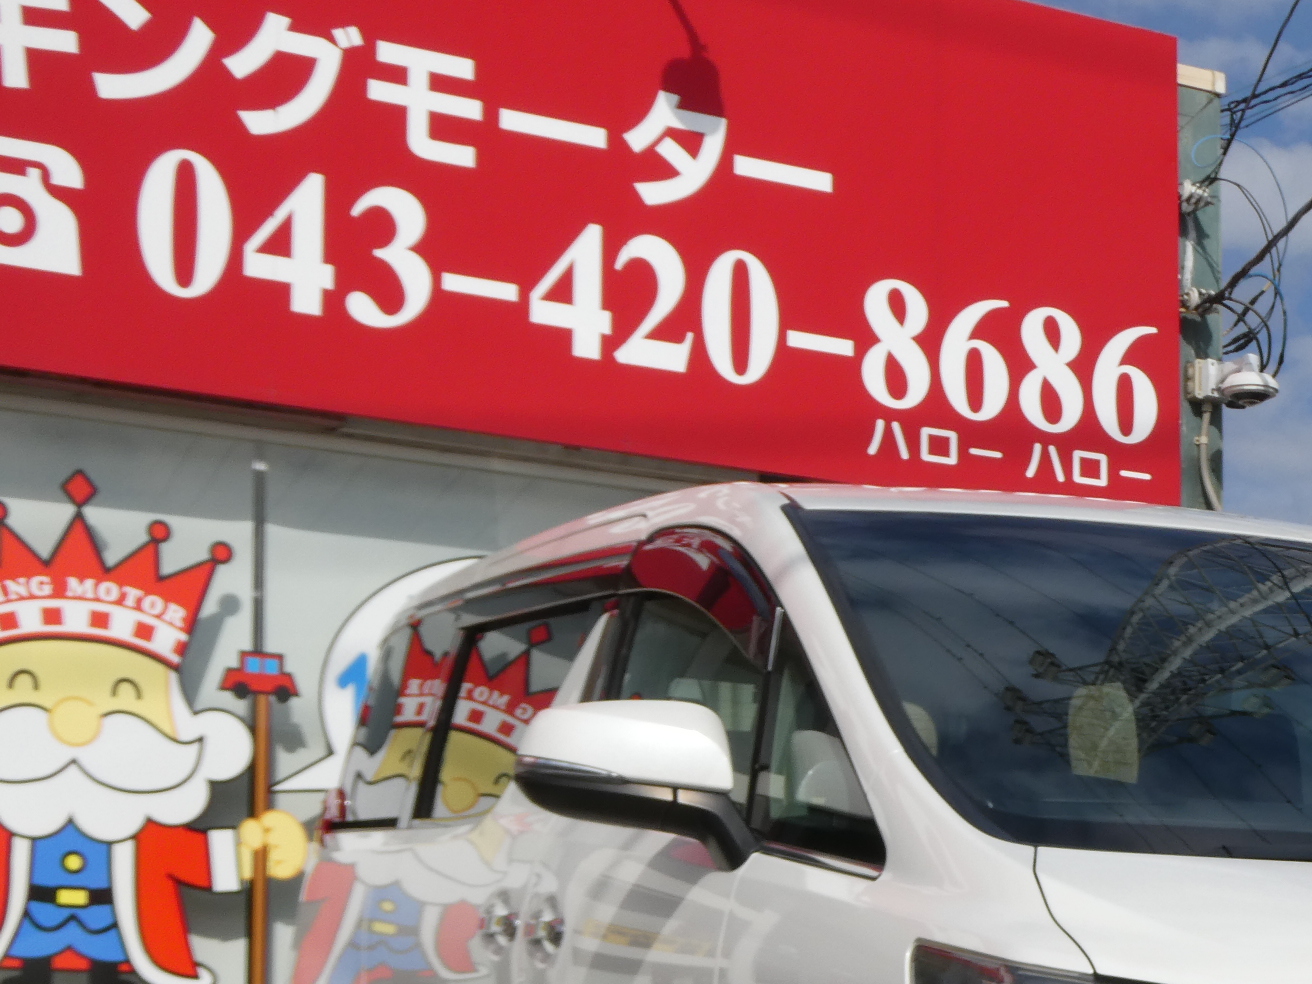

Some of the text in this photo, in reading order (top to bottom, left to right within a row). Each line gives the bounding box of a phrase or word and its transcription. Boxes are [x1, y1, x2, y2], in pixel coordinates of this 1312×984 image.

[866, 418, 1153, 487] ハロー ハロー
[65, 576, 188, 628] MOTOR
